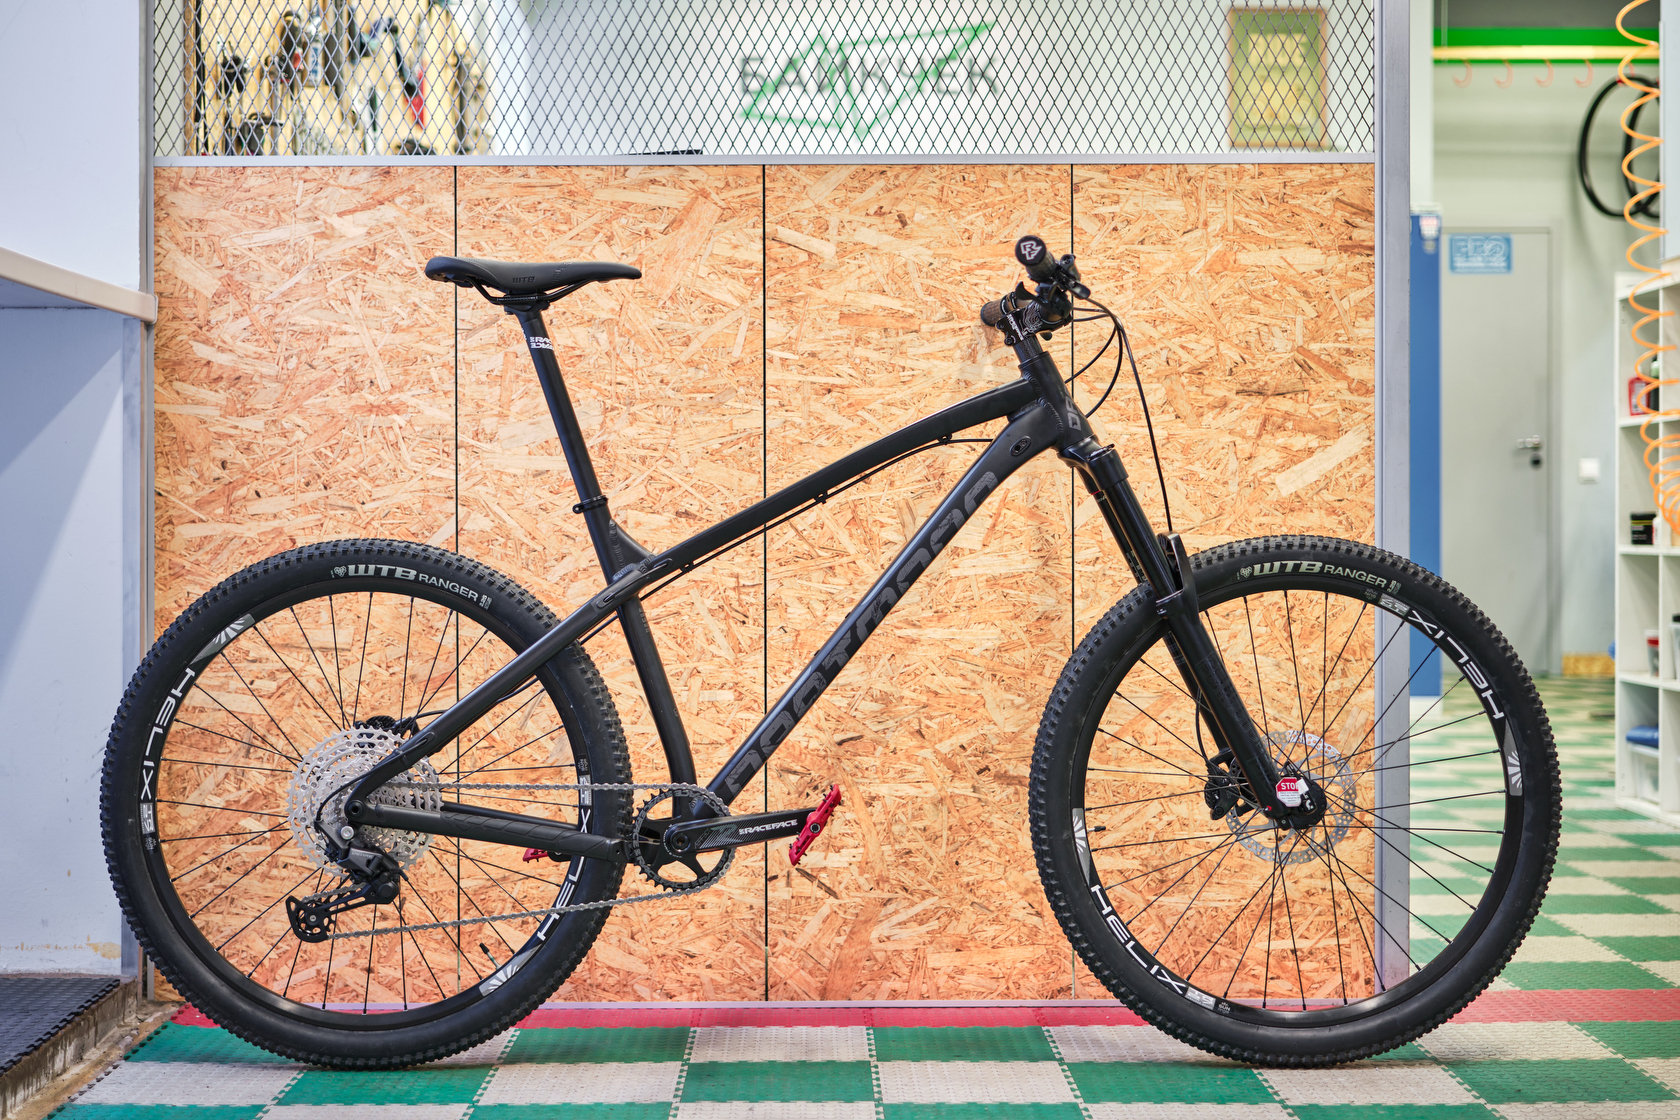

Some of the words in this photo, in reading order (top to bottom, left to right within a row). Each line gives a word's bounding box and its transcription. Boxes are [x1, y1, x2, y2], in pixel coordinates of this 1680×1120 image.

[348, 564, 418, 581] WTB
[418, 573, 479, 602] RANGER
[1253, 560, 1323, 576] WTB
[1323, 564, 1388, 589] RANGER
[1407, 609, 1505, 720] HELIX
[140, 667, 196, 801] HELIX
[1090, 884, 1187, 995] HELIX
